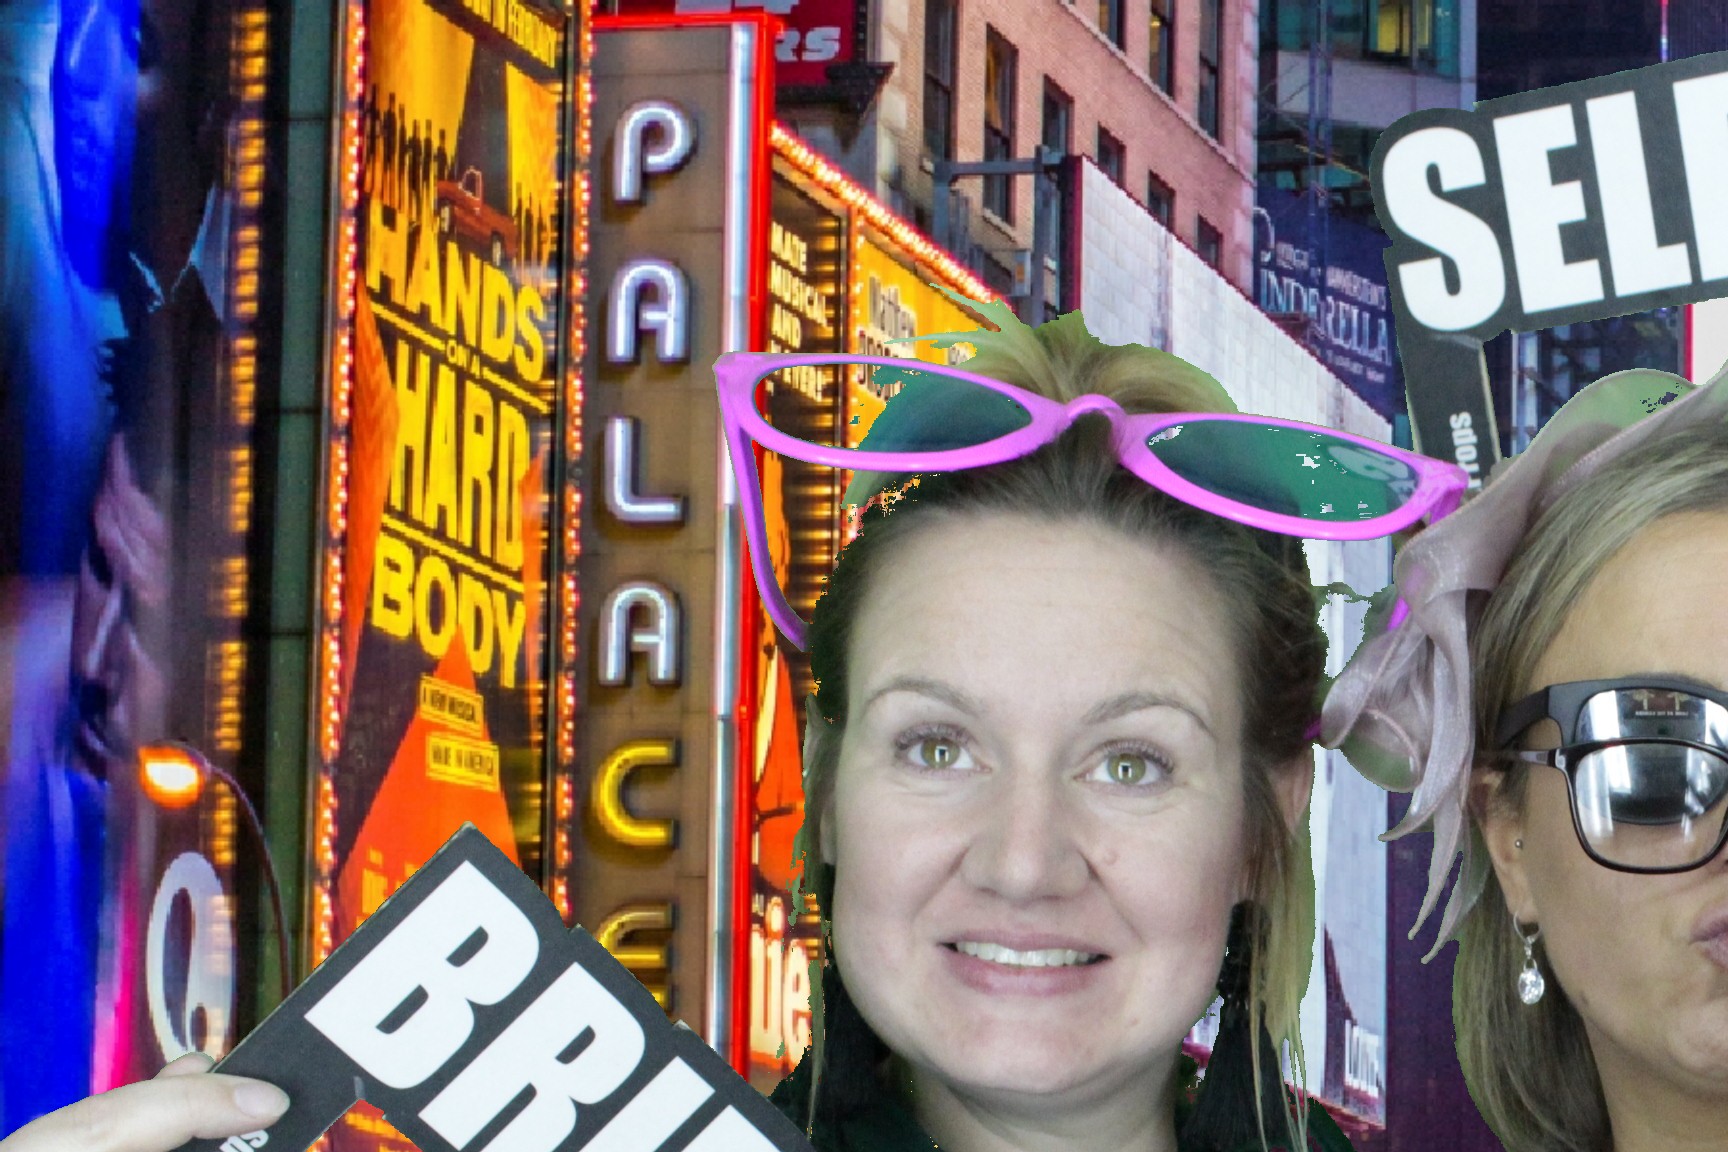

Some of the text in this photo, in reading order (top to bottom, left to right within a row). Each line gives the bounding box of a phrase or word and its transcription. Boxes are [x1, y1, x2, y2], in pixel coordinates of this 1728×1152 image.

[366, 192, 543, 382] HANDS
[390, 339, 530, 572] HARD
[1449, 411, 1483, 492] rops
[372, 528, 526, 690] BODY
